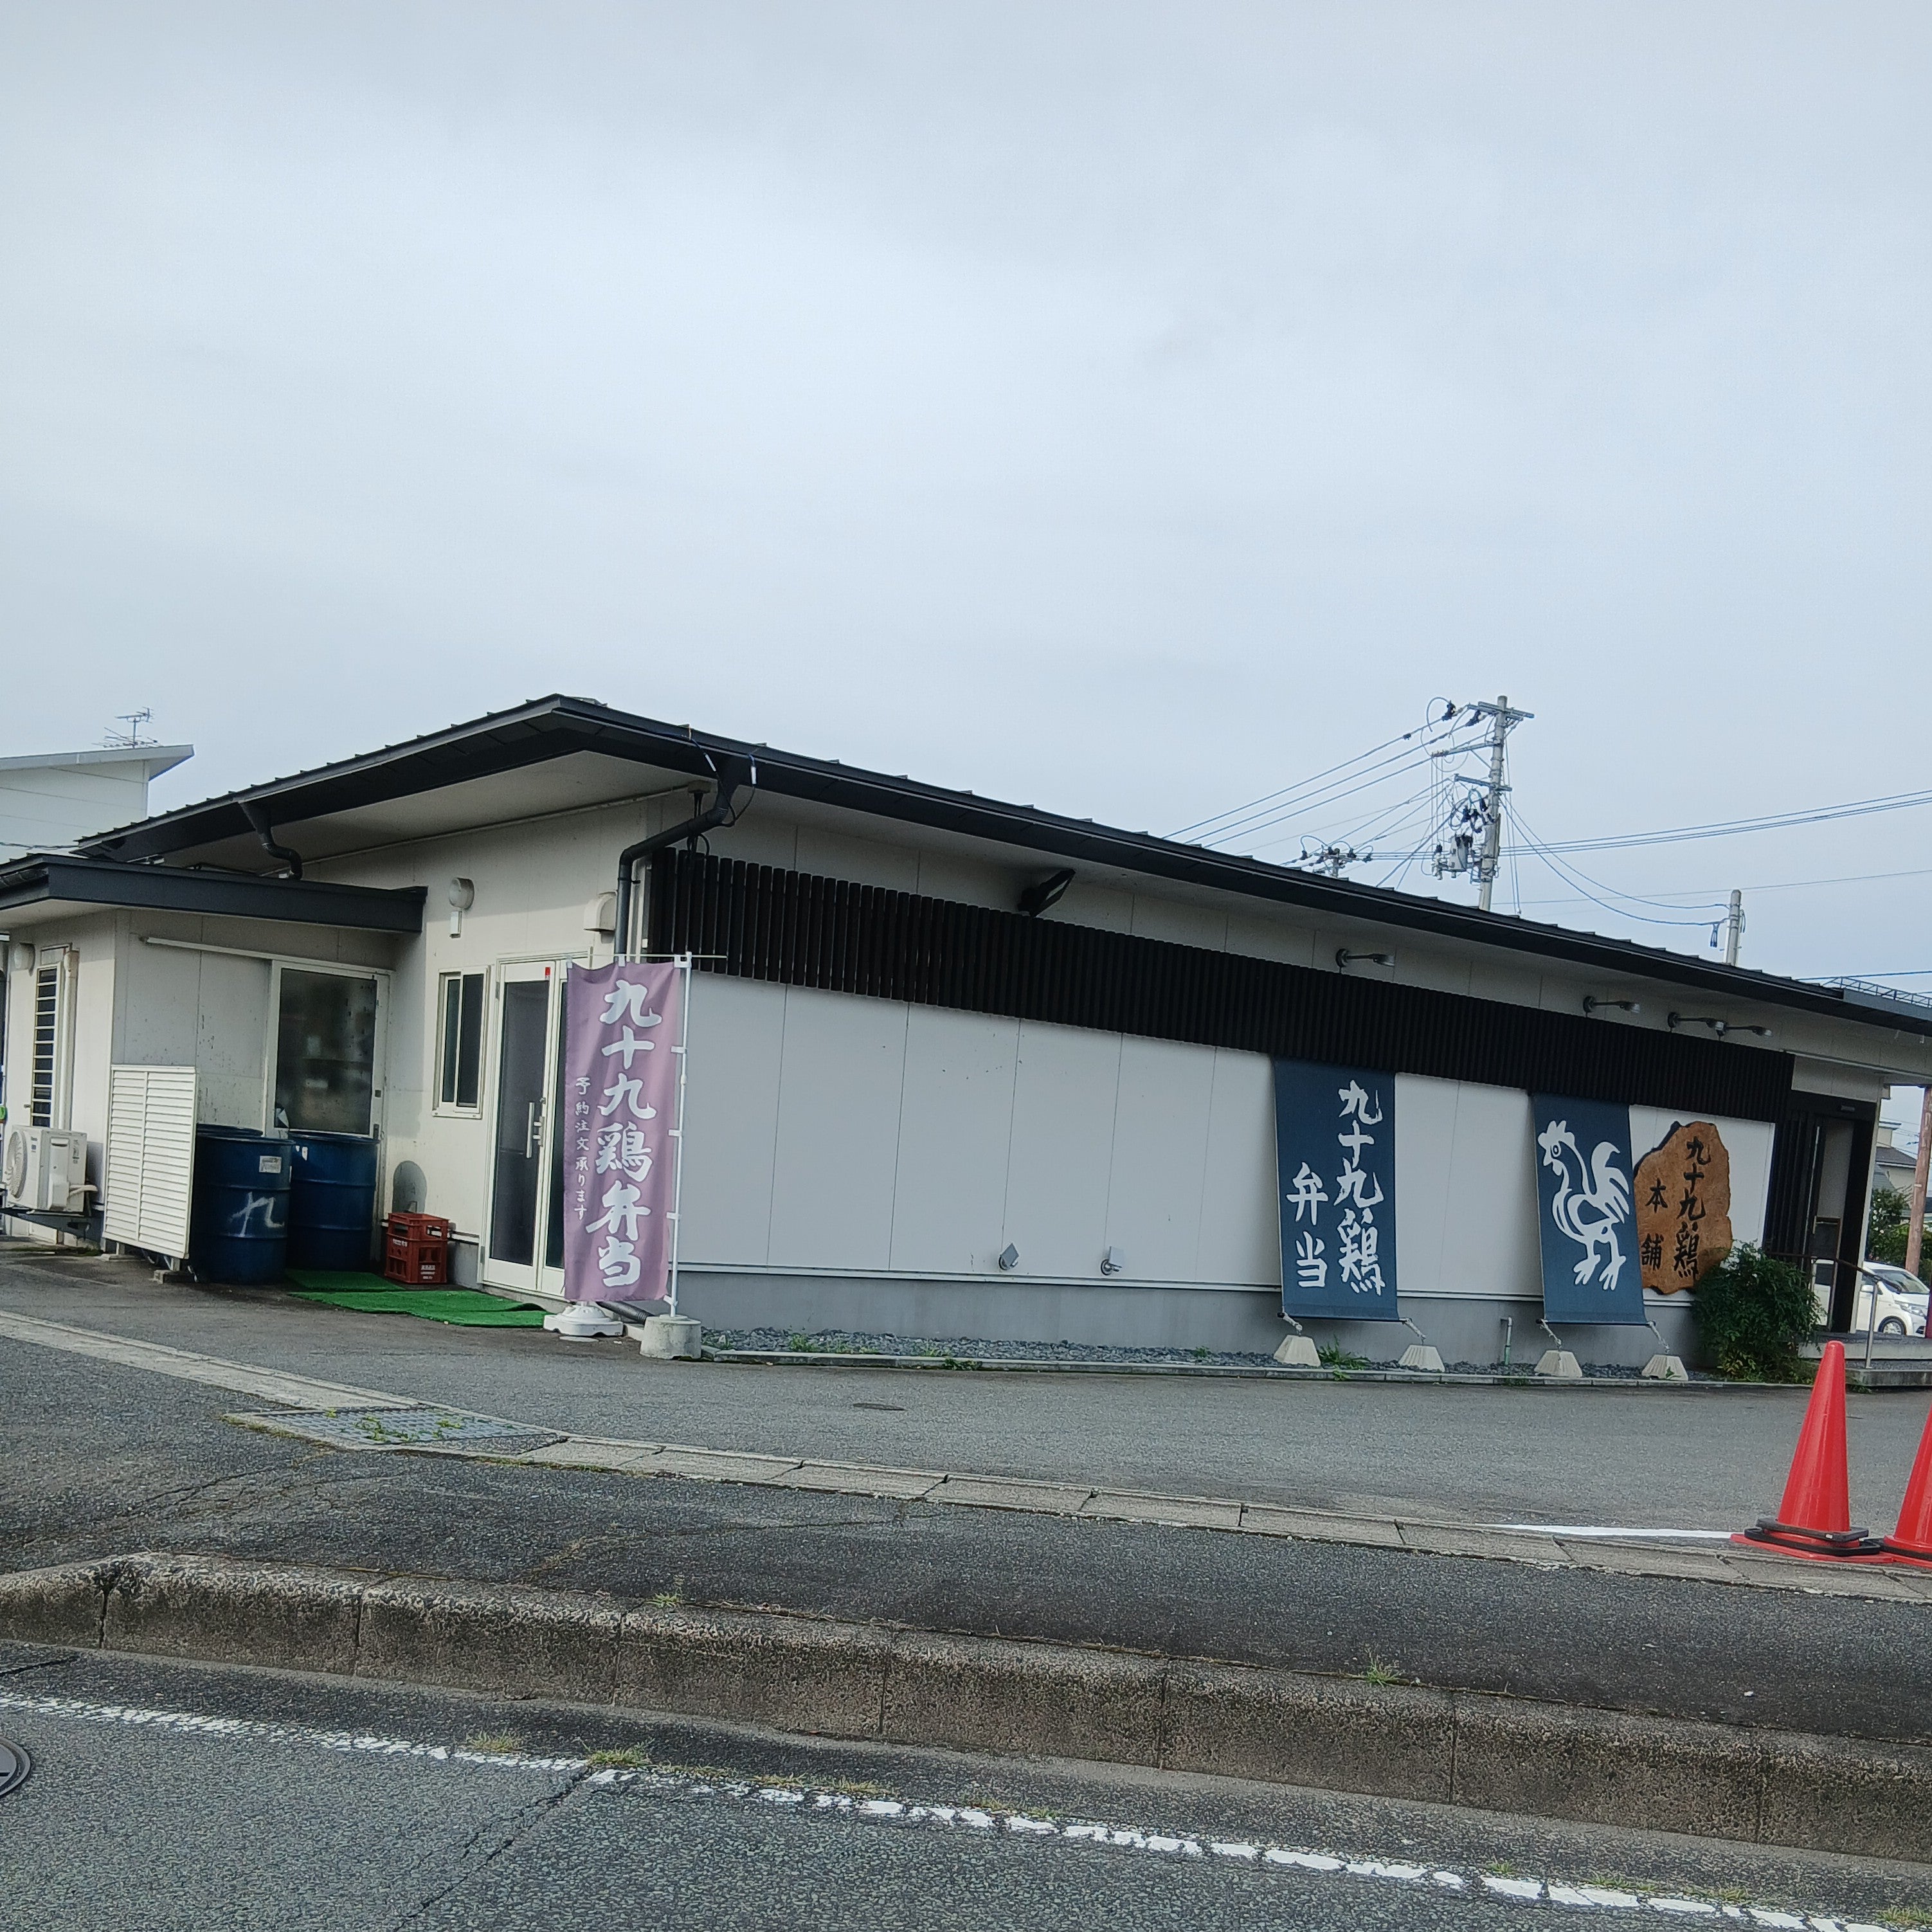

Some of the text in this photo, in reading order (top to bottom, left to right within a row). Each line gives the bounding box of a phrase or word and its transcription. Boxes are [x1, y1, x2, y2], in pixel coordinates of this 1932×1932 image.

[574, 1077, 591, 1220] 予約注文承ります
[586, 979, 662, 1286] 九十九鶏弁当
[1286, 1162, 1328, 1287] 弁当
[1641, 1178, 1668, 1271] 本舗
